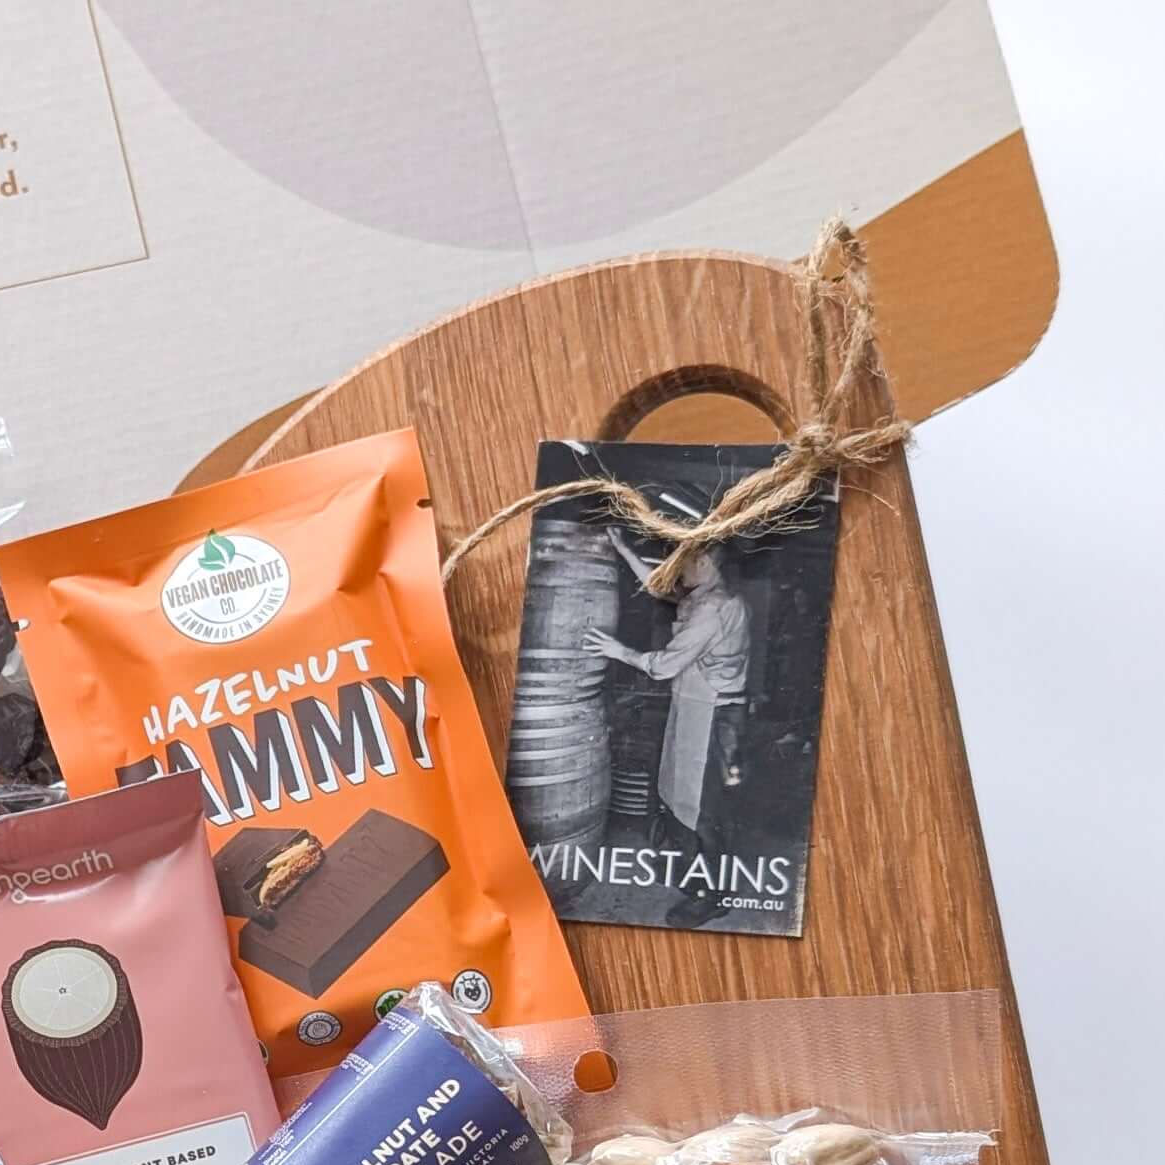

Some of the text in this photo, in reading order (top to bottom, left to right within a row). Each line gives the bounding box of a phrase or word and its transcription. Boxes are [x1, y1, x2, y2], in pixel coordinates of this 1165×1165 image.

[166, 559, 283, 608] VEGAN CHOCOLATE
[176, 586, 283, 639] HANDMADE IN SYDNEY
[142, 639, 372, 744] HAZELNUT
[717, 896, 784, 911] .com.au
[417, 1080, 460, 1124] AND
[167, 1146, 216, 1165] BASED
